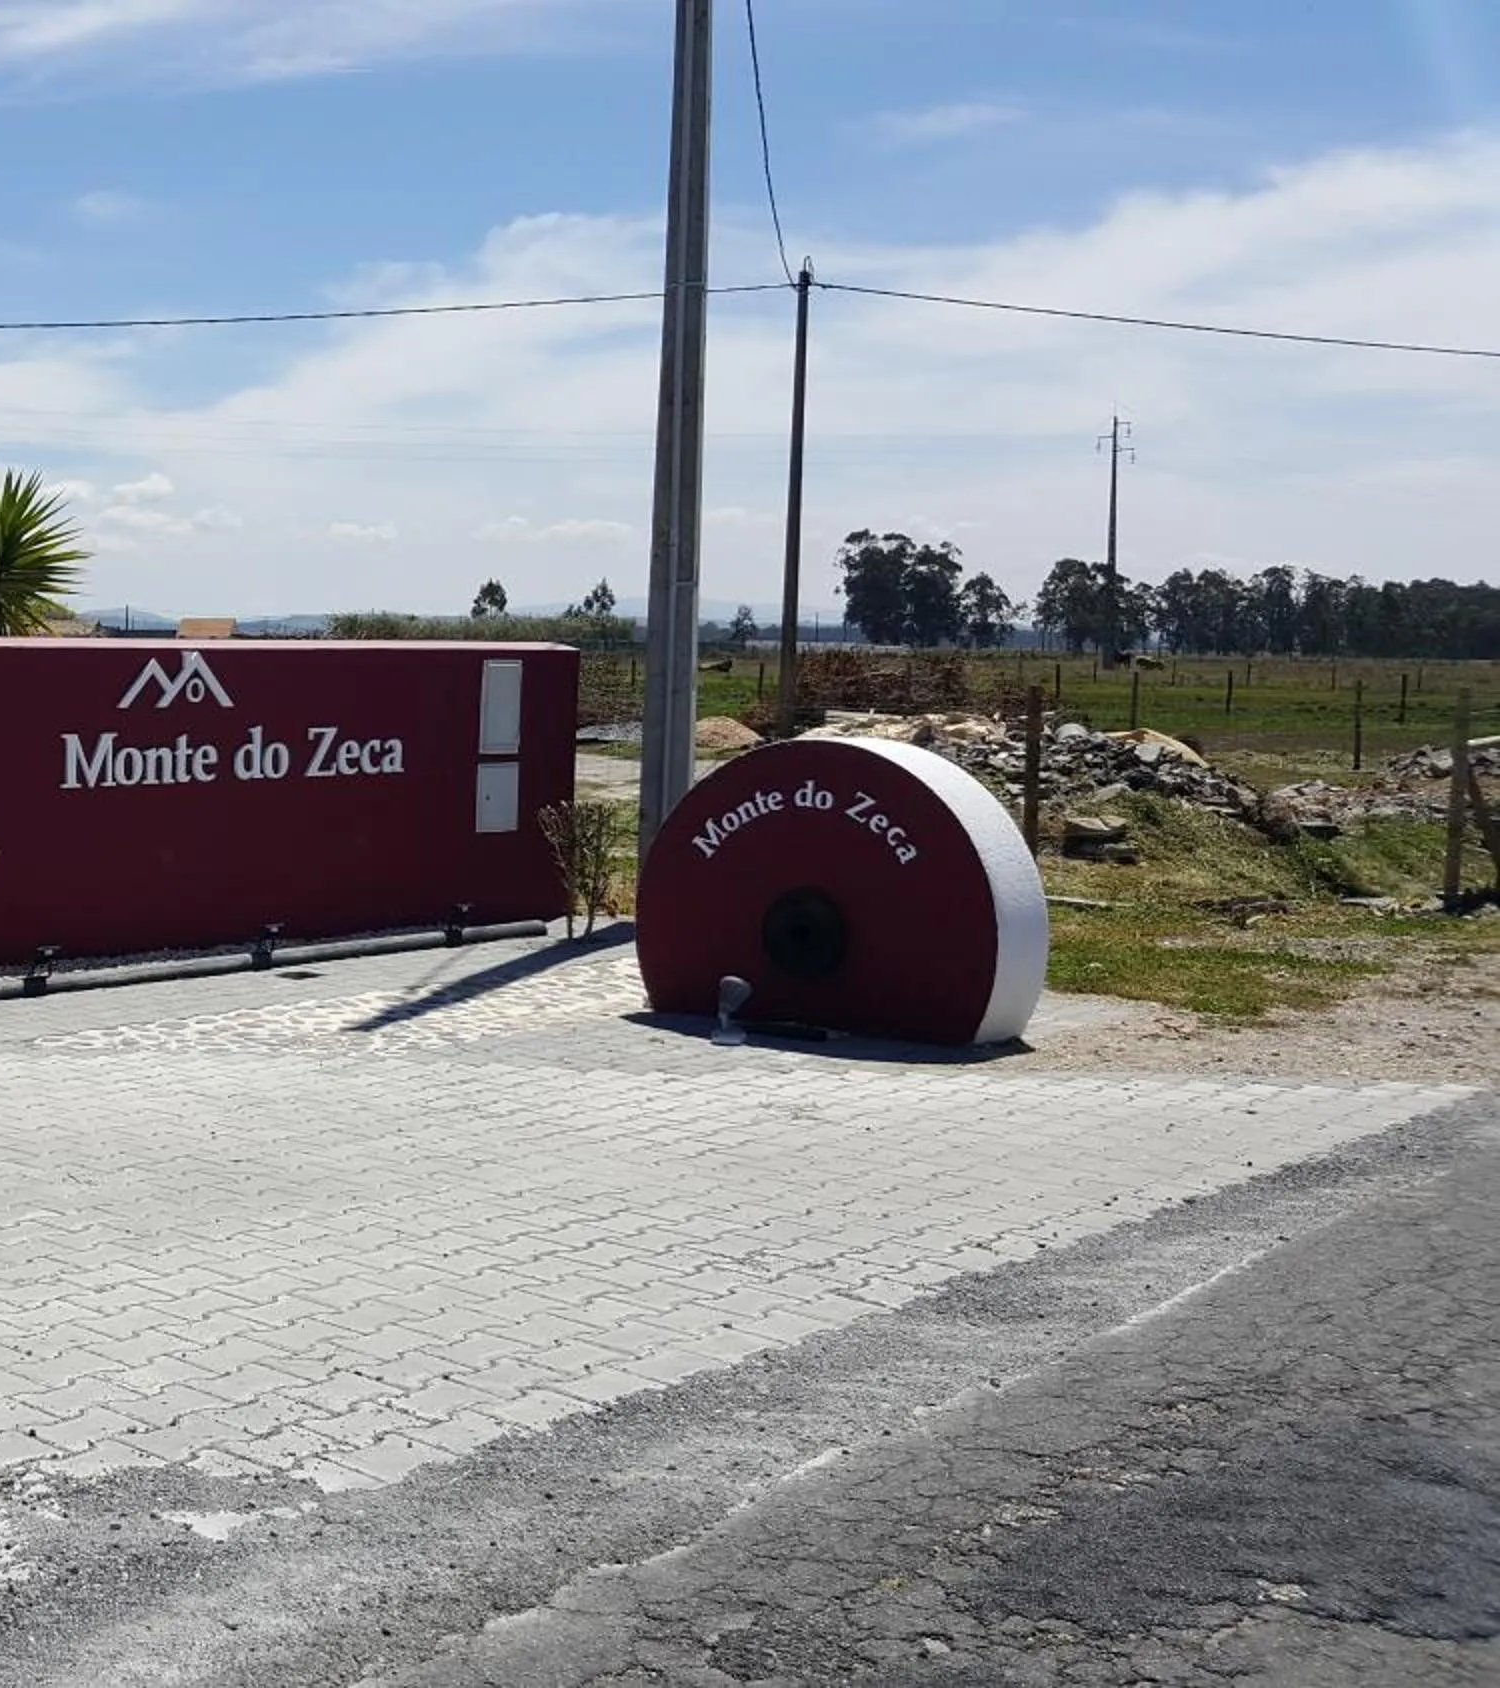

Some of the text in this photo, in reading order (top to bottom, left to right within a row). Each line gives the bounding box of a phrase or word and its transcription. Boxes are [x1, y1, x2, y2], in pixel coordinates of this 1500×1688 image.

[60, 725, 405, 790] Monte do Zeca
[691, 780, 918, 866] Monte do Zeca
